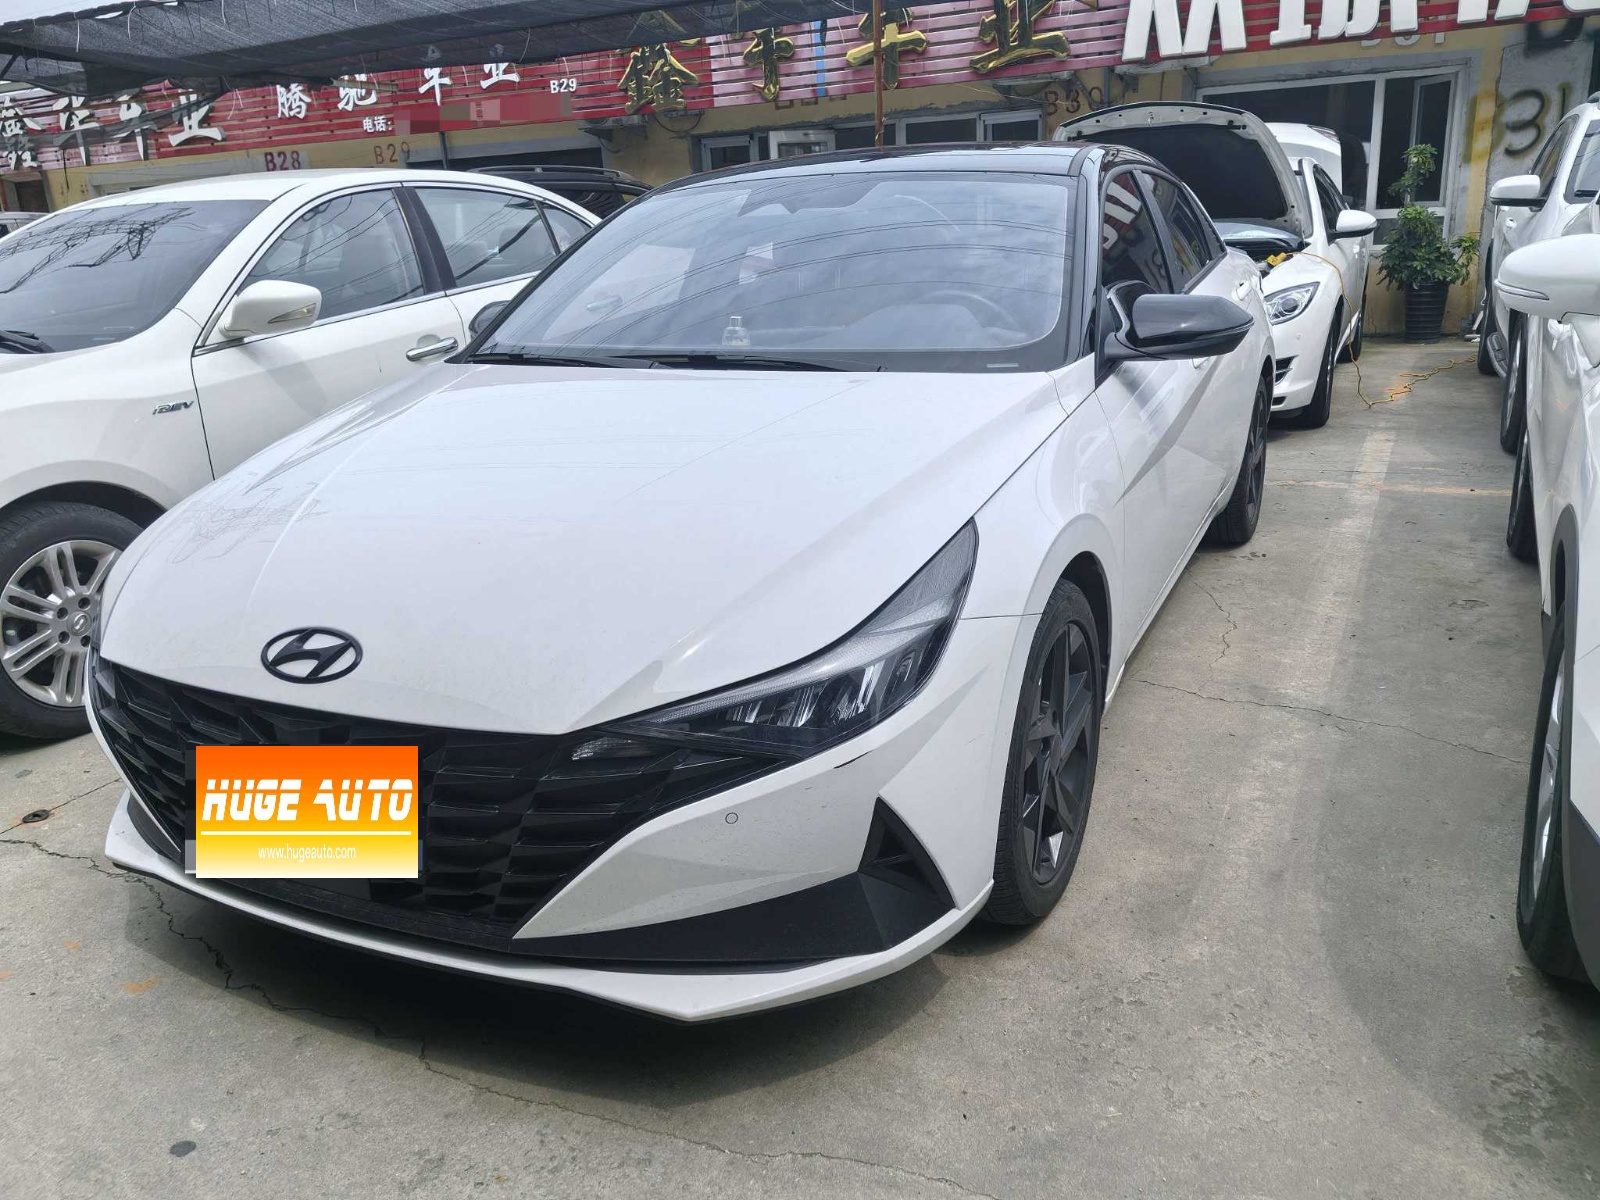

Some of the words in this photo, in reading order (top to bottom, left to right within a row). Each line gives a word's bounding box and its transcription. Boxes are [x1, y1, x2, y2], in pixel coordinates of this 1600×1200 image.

[549, 78, 577, 94] B29
[264, 150, 301, 172] B28
[373, 141, 411, 164] B29
